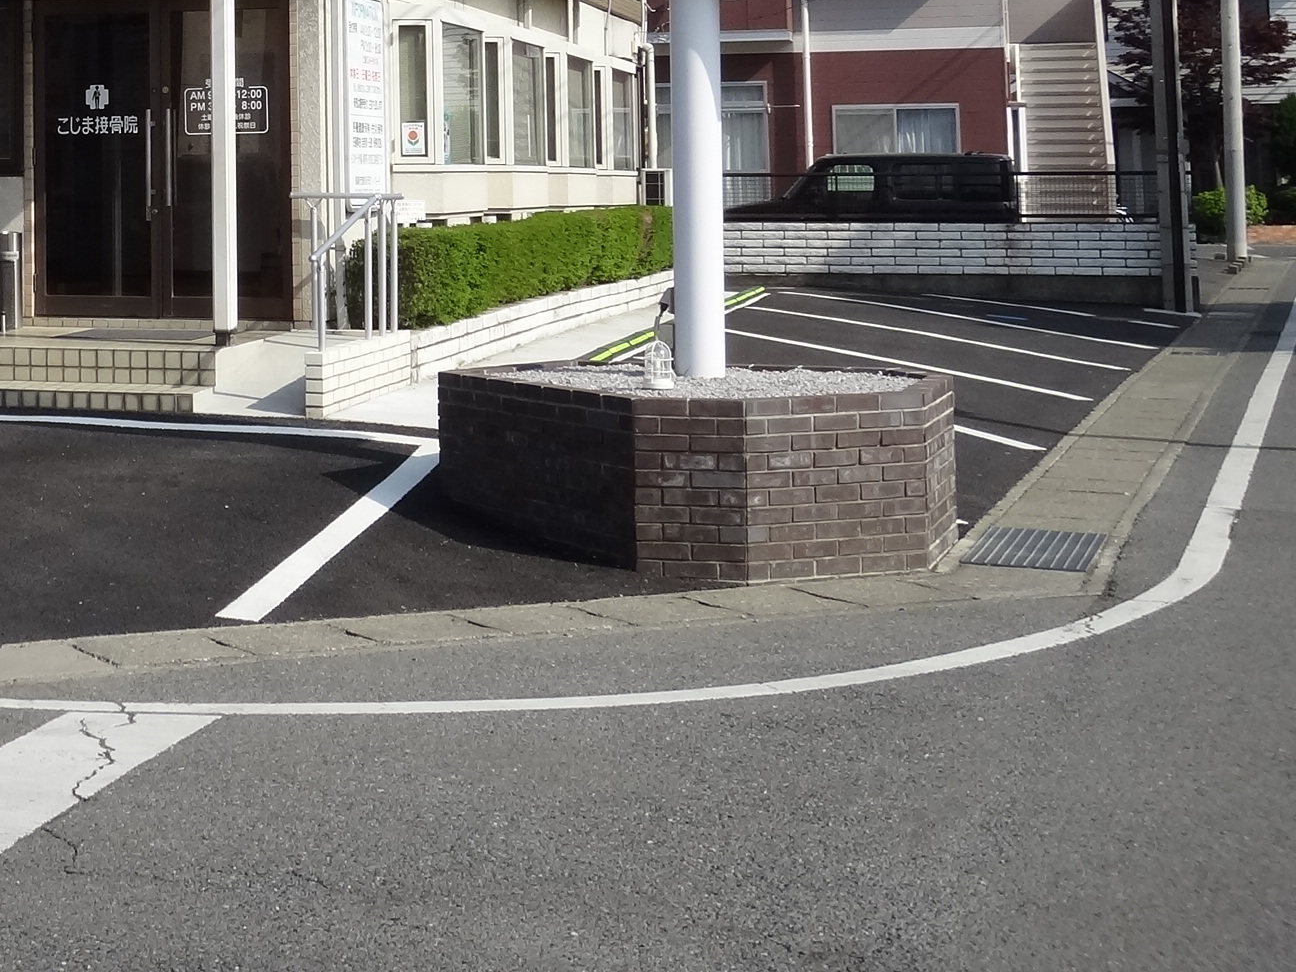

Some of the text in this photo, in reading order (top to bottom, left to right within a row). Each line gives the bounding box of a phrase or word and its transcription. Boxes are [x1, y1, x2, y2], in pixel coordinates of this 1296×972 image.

[190, 91, 205, 100] AM
[190, 102, 205, 111] PM
[57, 115, 139, 135] こじま接骨院
